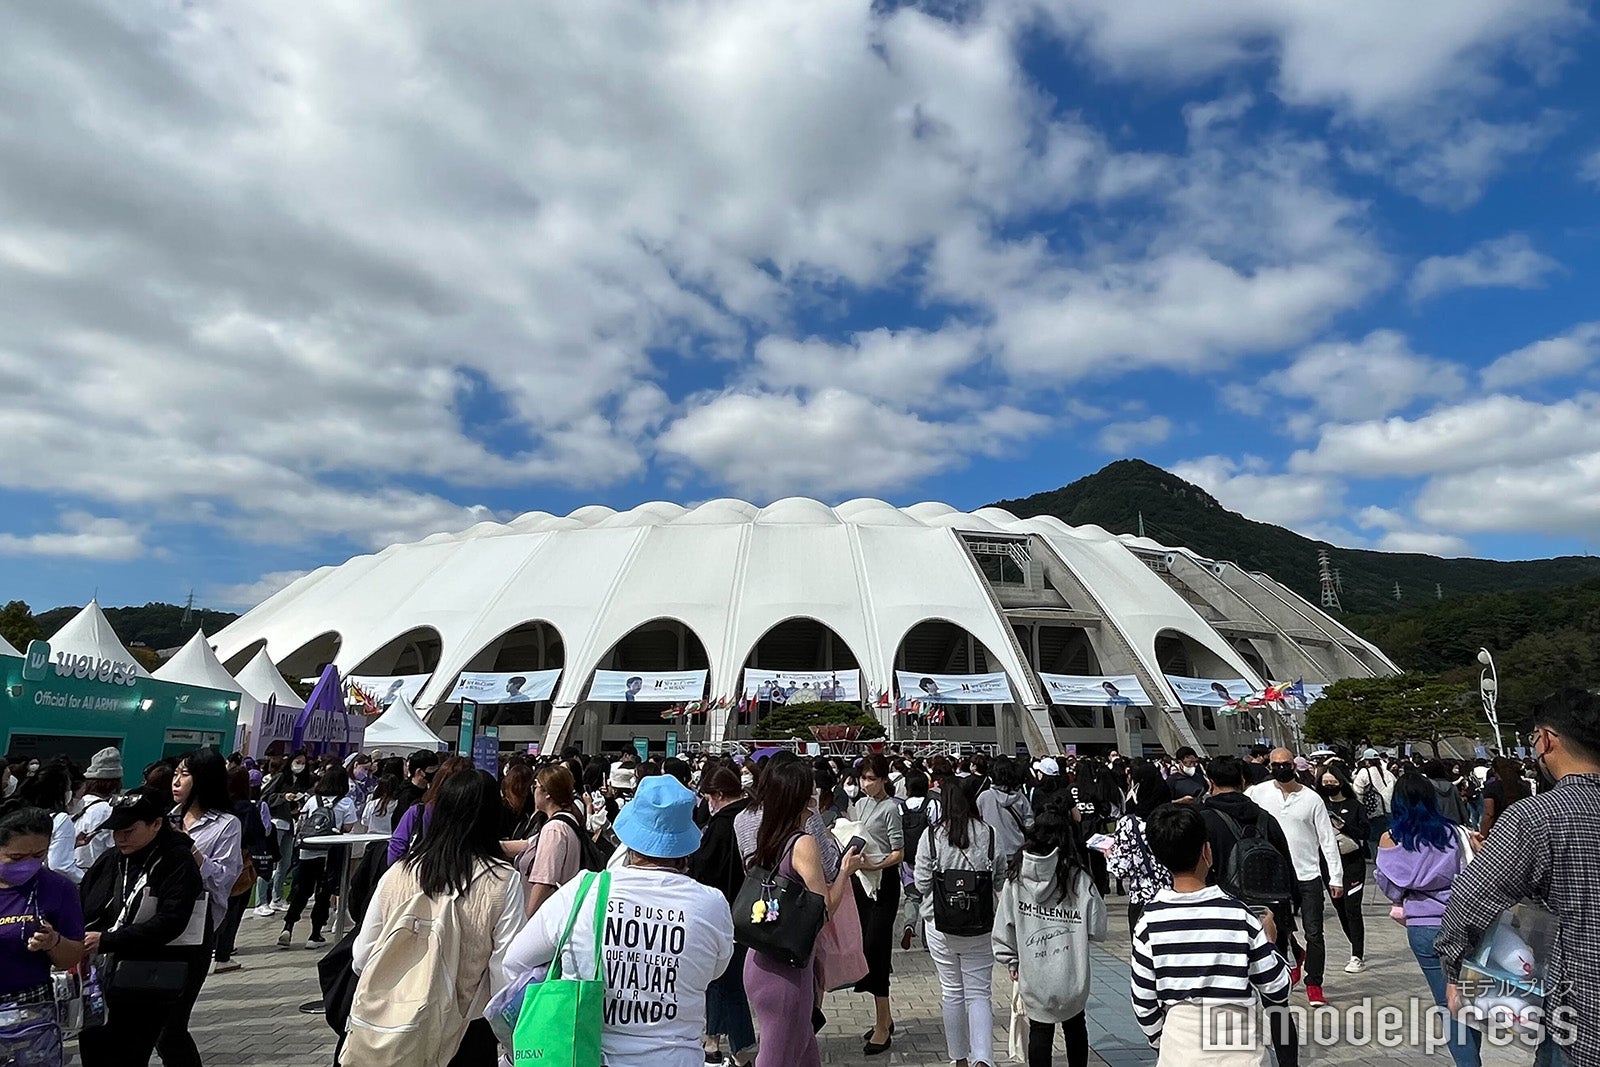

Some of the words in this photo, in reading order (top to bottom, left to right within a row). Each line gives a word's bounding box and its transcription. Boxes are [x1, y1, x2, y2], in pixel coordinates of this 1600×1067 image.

[55, 651, 138, 686] weverse
[34, 690, 69, 707] Official
[68, 694, 81, 708] for
[81, 695, 94, 709] All
[94, 698, 119, 711] ARMY
[607, 900, 625, 914] SE
[634, 905, 685, 923] BUSCA
[604, 916, 686, 955] NOVIO
[605, 949, 624, 962] QUE
[626, 951, 641, 963] ME
[607, 960, 677, 994] VIAJAR
[603, 988, 639, 1001] OR
[603, 997, 678, 1026] MUNDO
[515, 1049, 544, 1060] BUSAN
